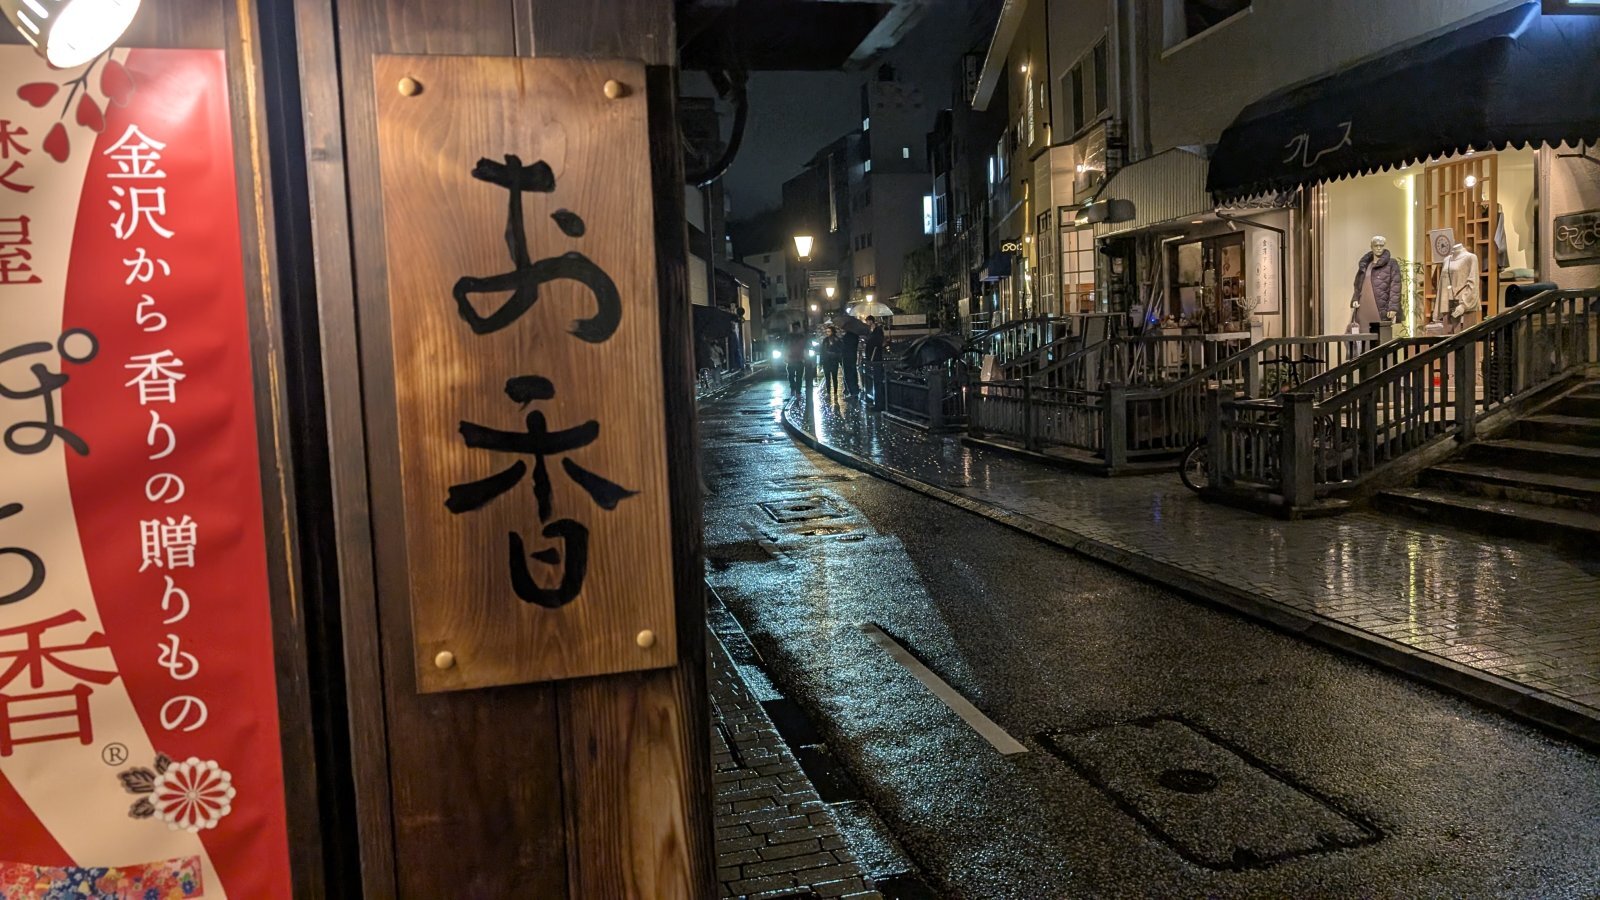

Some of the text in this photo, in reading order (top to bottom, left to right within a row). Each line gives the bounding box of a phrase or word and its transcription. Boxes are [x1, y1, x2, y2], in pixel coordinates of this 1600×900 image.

[103, 124, 208, 733] 金沢から香りの贈りもの
[444, 153, 641, 609] お香
